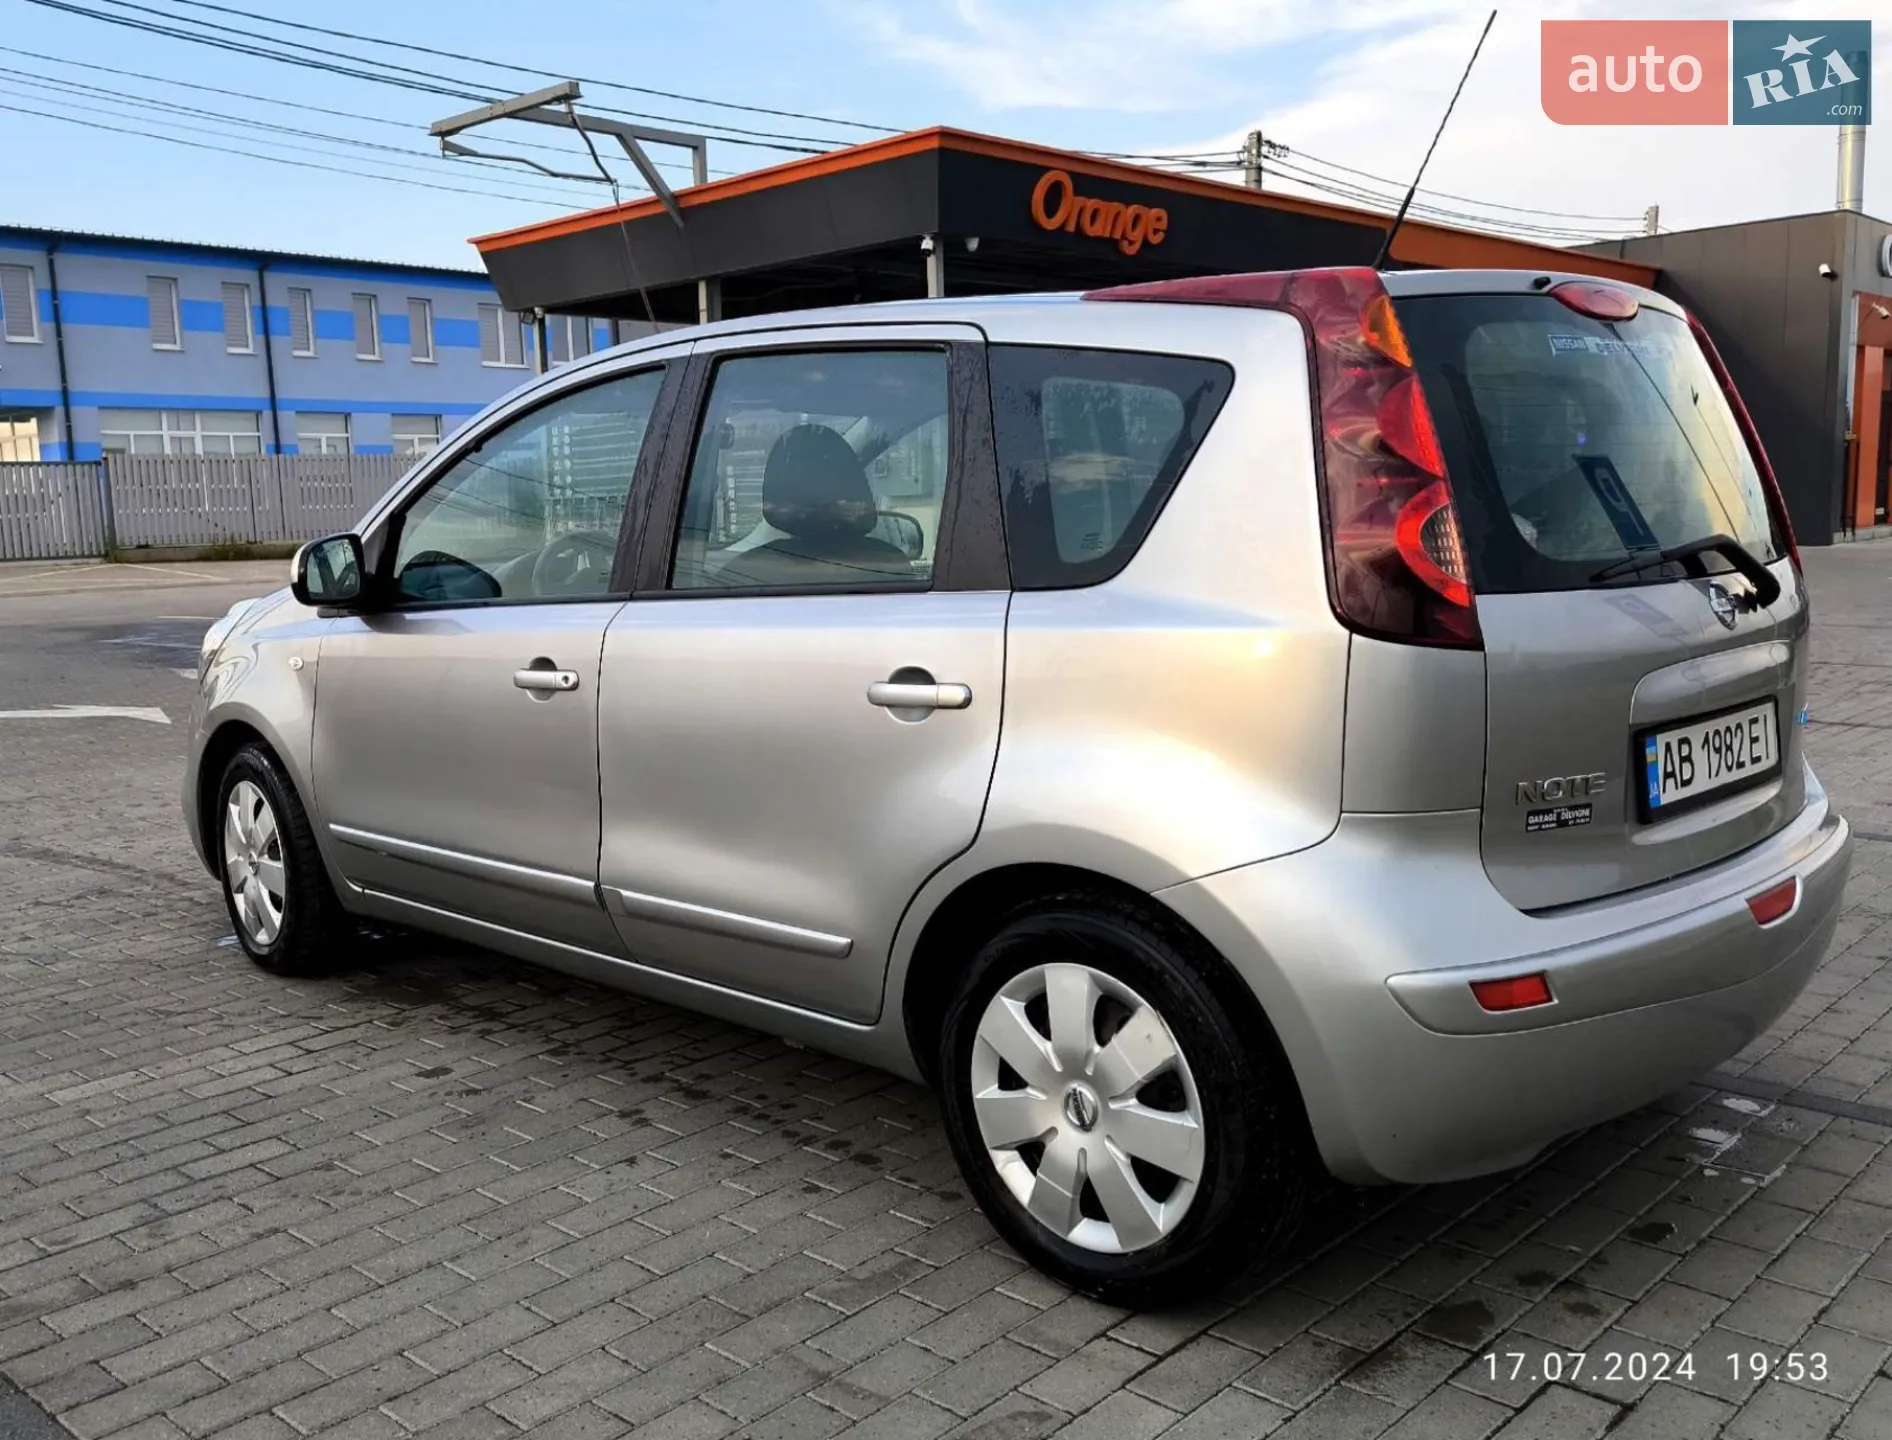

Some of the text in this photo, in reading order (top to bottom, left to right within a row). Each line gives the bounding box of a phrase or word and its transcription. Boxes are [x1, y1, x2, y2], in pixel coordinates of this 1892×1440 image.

[1031, 169, 1168, 256] Orange
[1662, 713, 1770, 793] AB 1982 EI
[1515, 772, 1607, 805] NOTE
[1527, 813, 1558, 825] GARAGE
